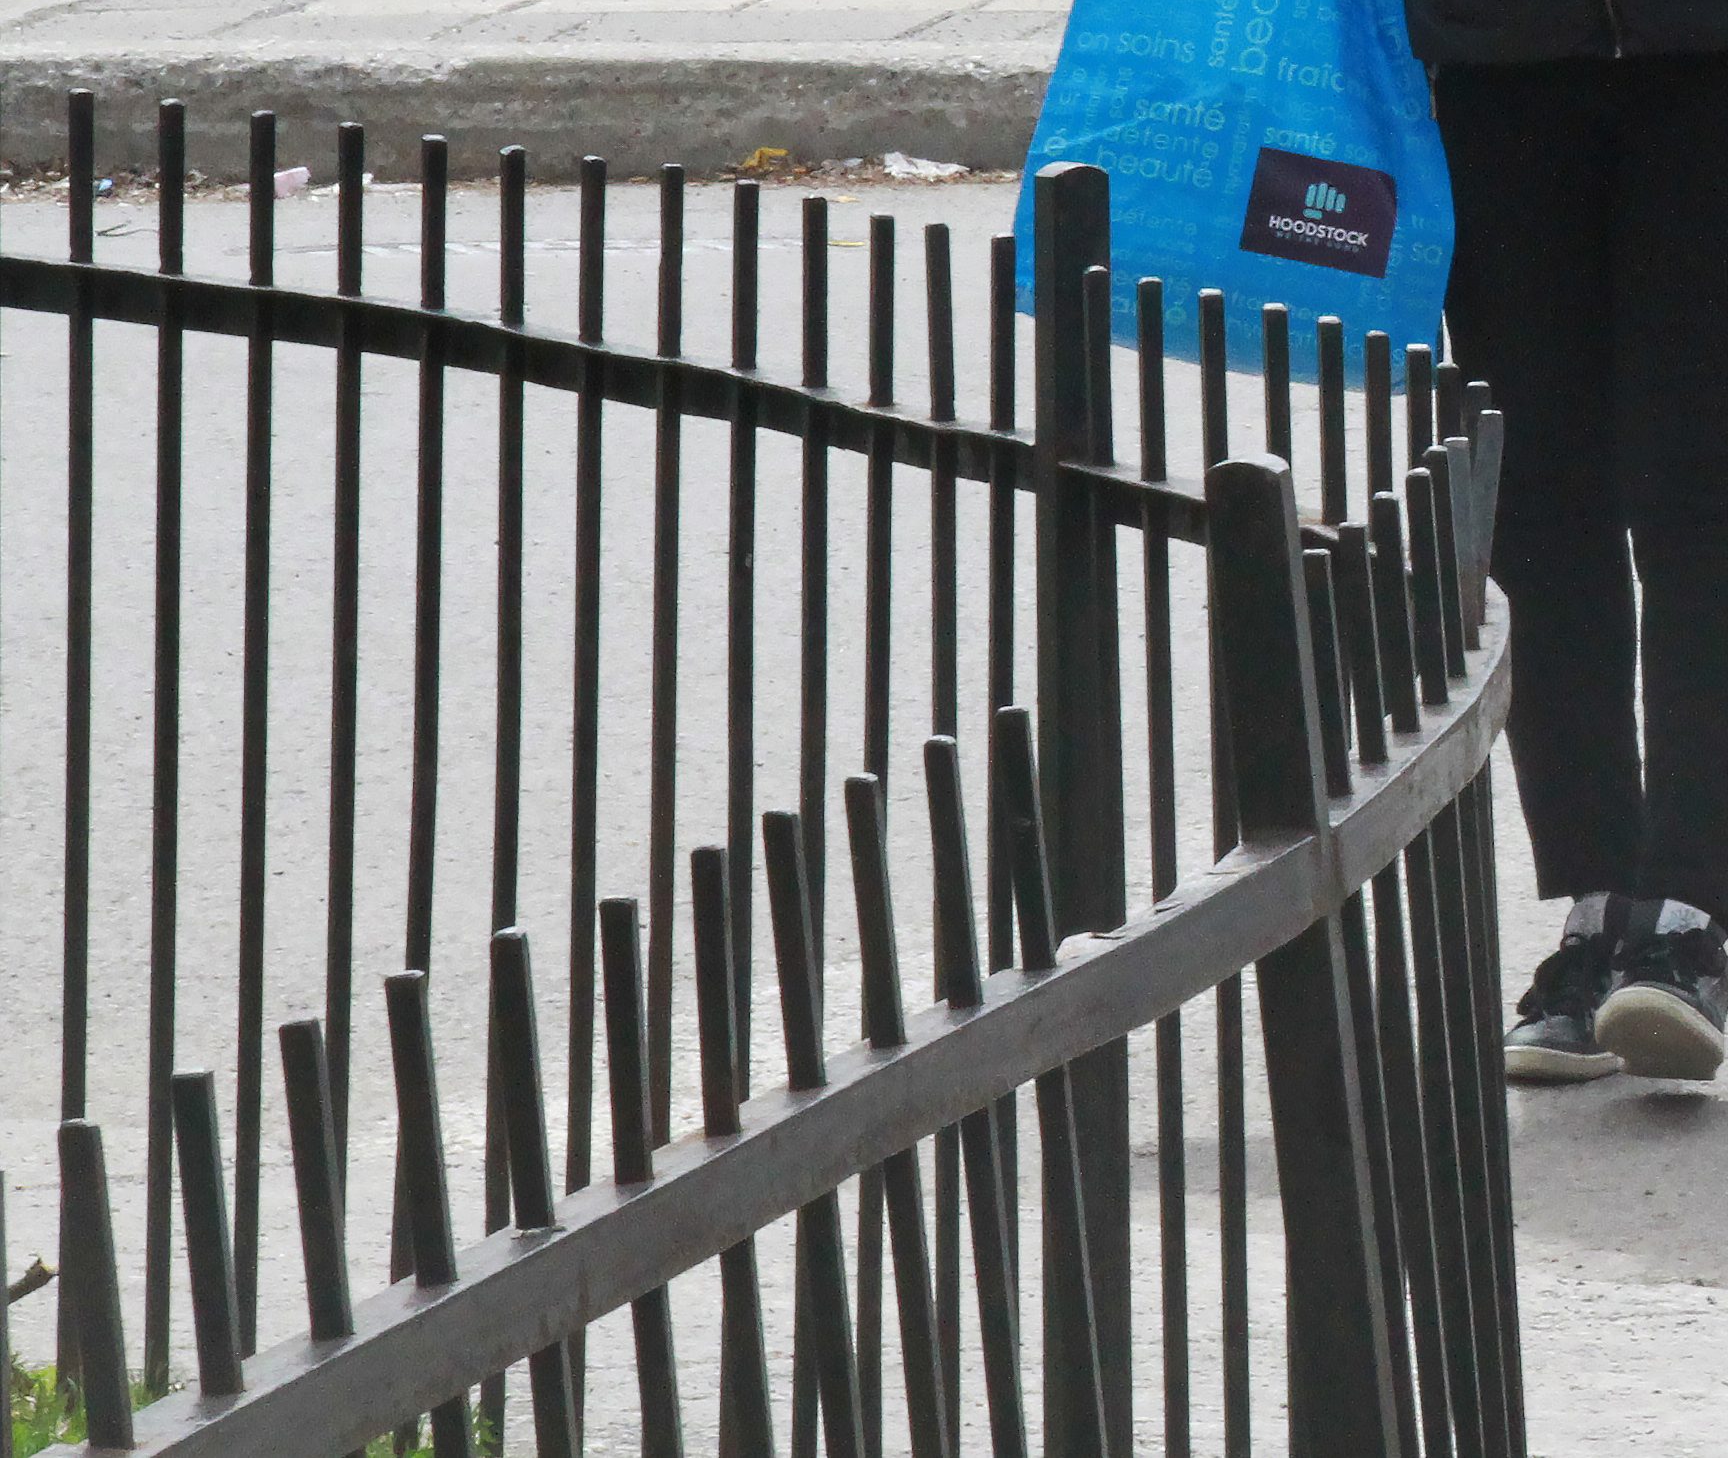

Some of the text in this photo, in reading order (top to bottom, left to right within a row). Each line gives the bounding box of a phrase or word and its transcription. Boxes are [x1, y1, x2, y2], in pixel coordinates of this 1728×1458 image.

[1116, 30, 1196, 64] soins
[1133, 98, 1227, 133] santé
[1263, 126, 1337, 156] santé
[1096, 144, 1213, 188] beauté
[1268, 214, 1369, 247] HOODSTOCK
